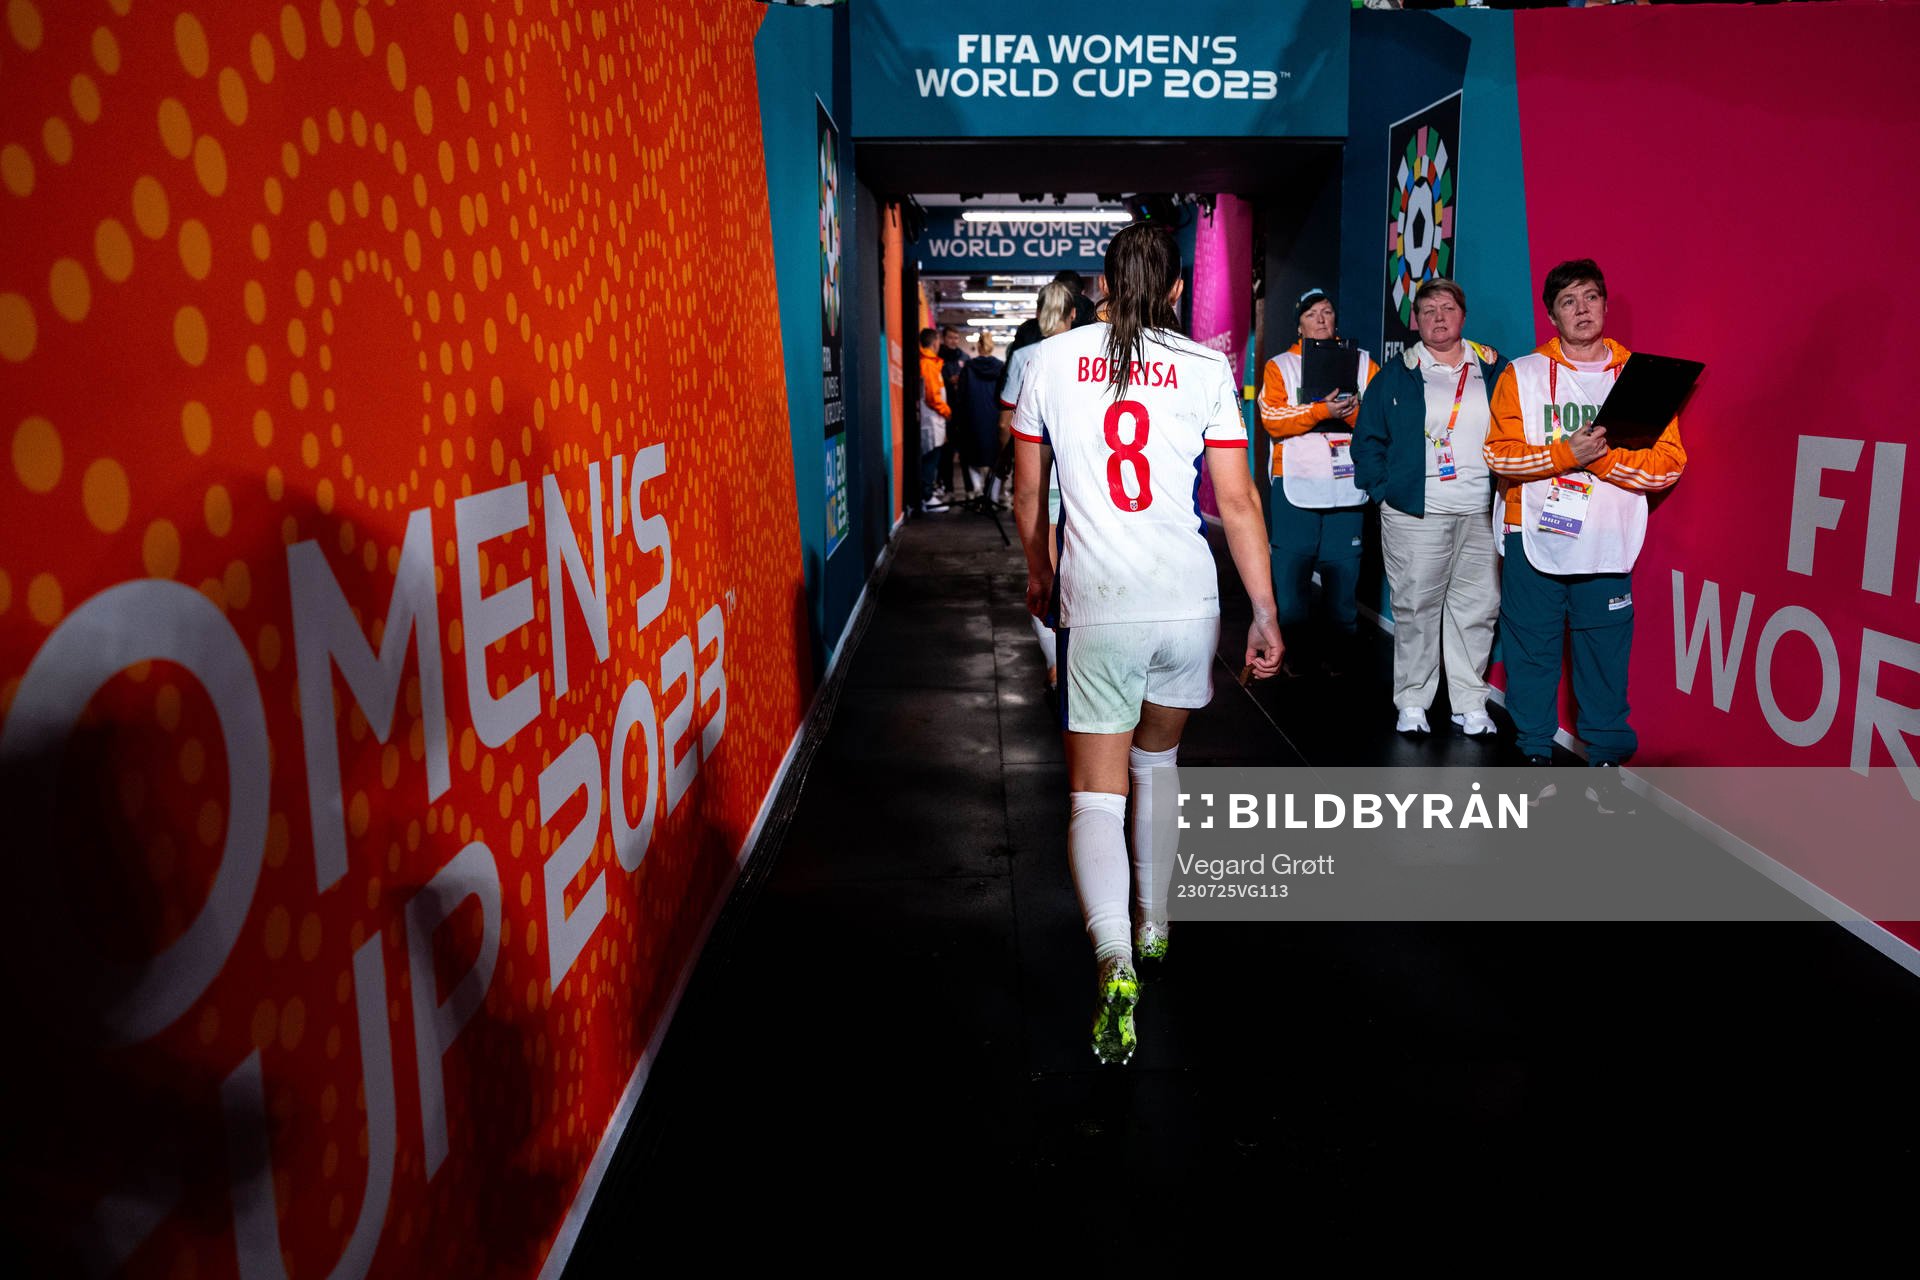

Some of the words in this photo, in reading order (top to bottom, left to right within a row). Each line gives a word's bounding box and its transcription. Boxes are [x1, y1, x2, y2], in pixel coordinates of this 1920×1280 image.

[958, 34, 1040, 63] FIFA
[1047, 34, 1237, 65] WOMEN'S
[915, 68, 1059, 98] WORLD
[1072, 68, 1152, 98] CUP
[953, 219, 1004, 237] FIFA
[929, 239, 1015, 257] WORLD
[1023, 239, 1072, 257] CUP
[1079, 240, 1111, 257] 20
[1103, 400, 1153, 512] 8
[1786, 434, 1920, 604] FI
